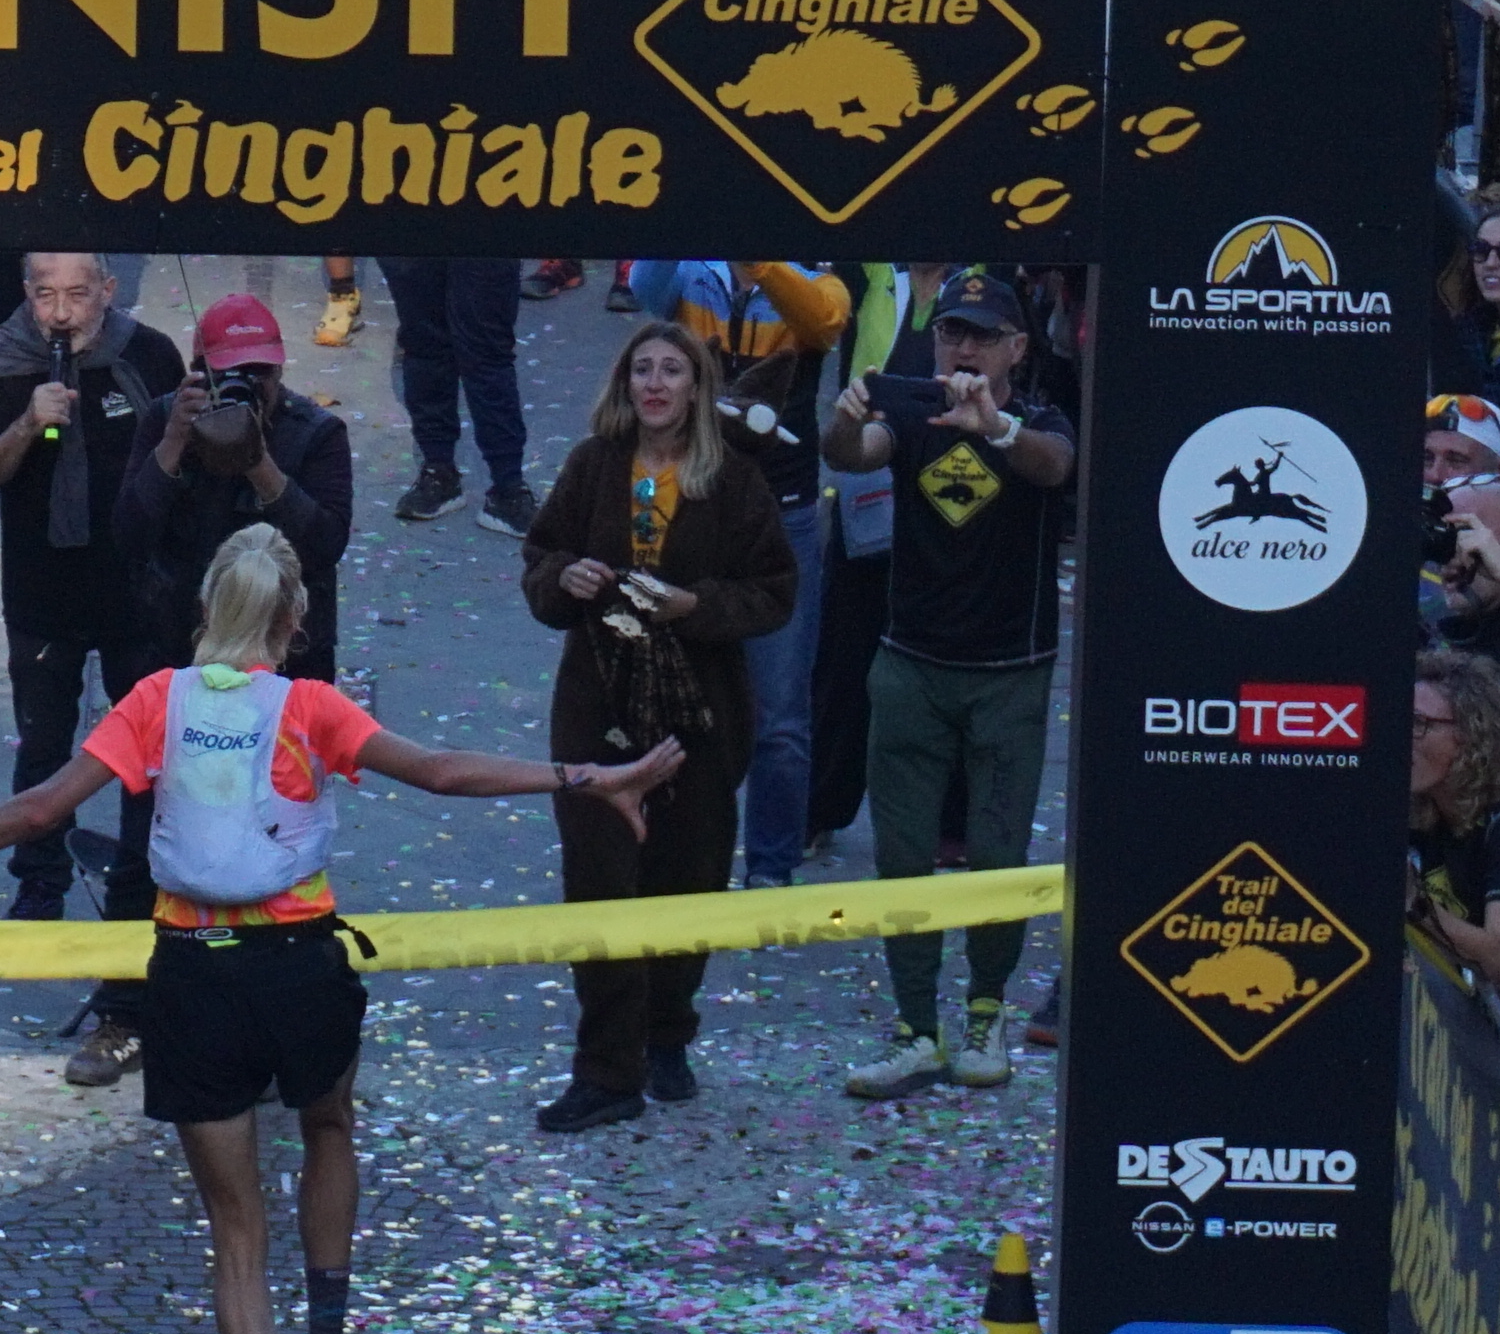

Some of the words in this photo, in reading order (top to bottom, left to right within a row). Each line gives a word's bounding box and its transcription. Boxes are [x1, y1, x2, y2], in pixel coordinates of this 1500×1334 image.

[83, 101, 662, 224] Cinghiale
[1151, 288, 1195, 309] LA
[1206, 289, 1391, 315] SPORTIVA
[1150, 314, 1257, 329] innovation
[1264, 316, 1306, 330] with
[1314, 318, 1390, 335] passion
[1192, 532, 1253, 560] alce
[1261, 537, 1328, 561] nero
[1145, 700, 1359, 738] BIOTEX
[181, 727, 263, 750] BROOKS
[1145, 751, 1251, 764] UNDERWEAR
[1262, 754, 1358, 766] INNOVATOR
[1215, 875, 1278, 899] Trail
[1222, 896, 1264, 916] del
[1163, 913, 1332, 947] Cinghiale
[1132, 1221, 1195, 1234] NISSAN
[1206, 1219, 1338, 1238] e-POWER
